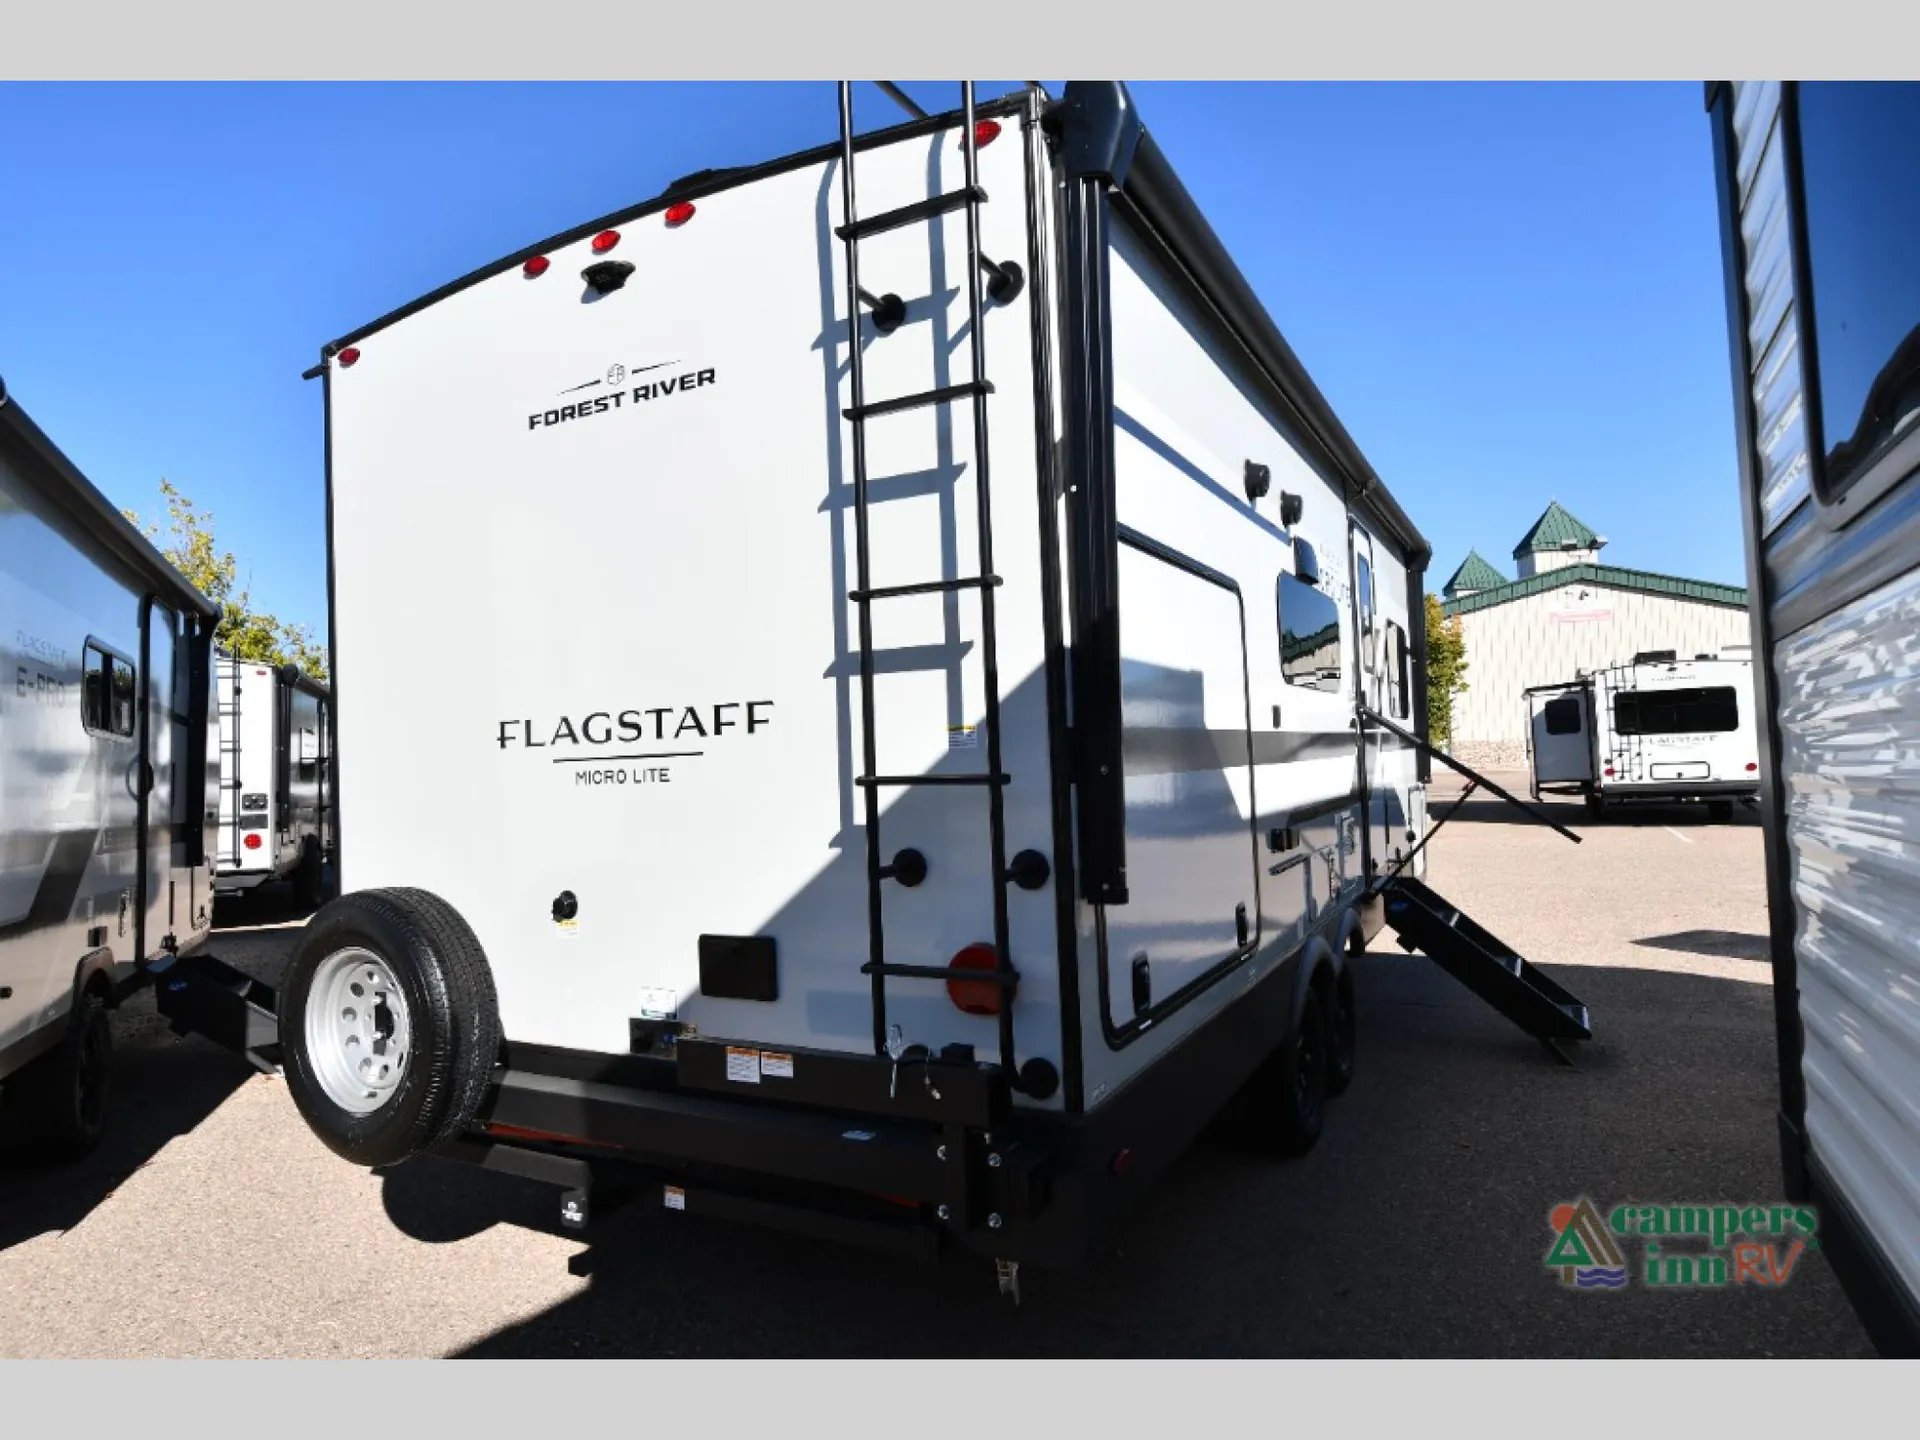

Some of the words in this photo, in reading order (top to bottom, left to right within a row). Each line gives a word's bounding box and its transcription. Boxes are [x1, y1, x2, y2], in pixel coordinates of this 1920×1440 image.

[528, 391, 626, 431] FOREST
[632, 367, 716, 404] RIVER
[496, 700, 775, 749] FLAGSTAFF
[575, 768, 627, 786] MICRO
[632, 768, 671, 784] LITE
